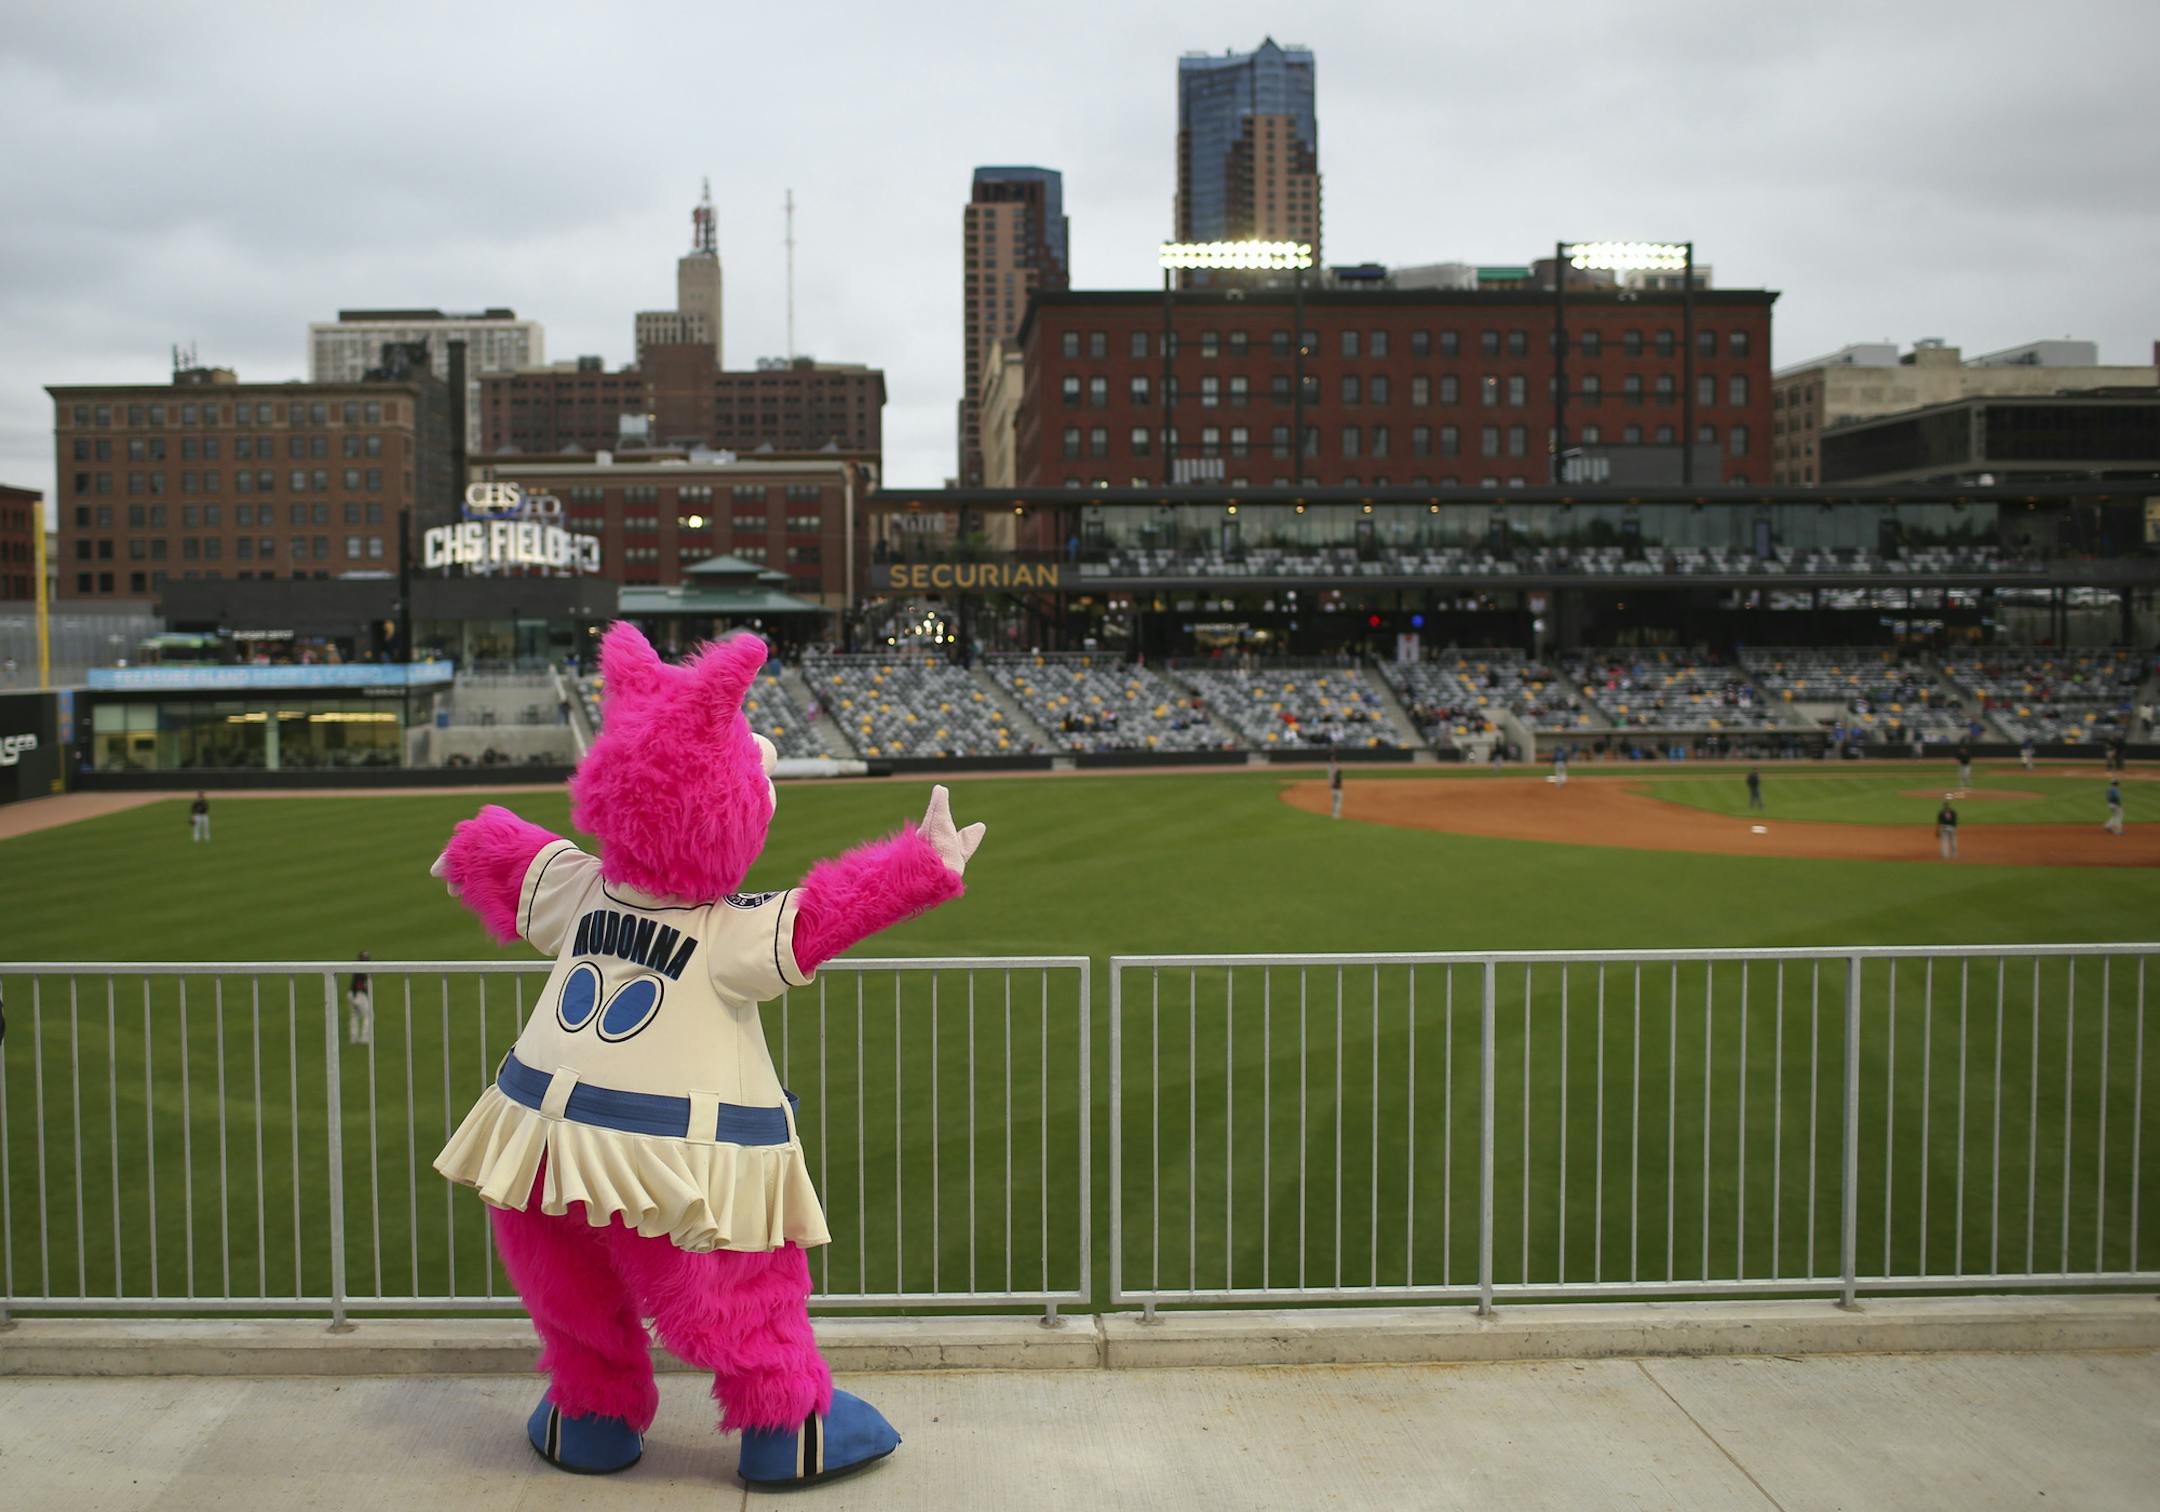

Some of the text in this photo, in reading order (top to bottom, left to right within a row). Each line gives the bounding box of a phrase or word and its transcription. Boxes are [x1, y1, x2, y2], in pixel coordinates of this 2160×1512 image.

[465, 482, 521, 508] CHS
[424, 521, 483, 569] CHS
[490, 520, 565, 566] FIELD
[889, 564, 1059, 588] SECURIAN
